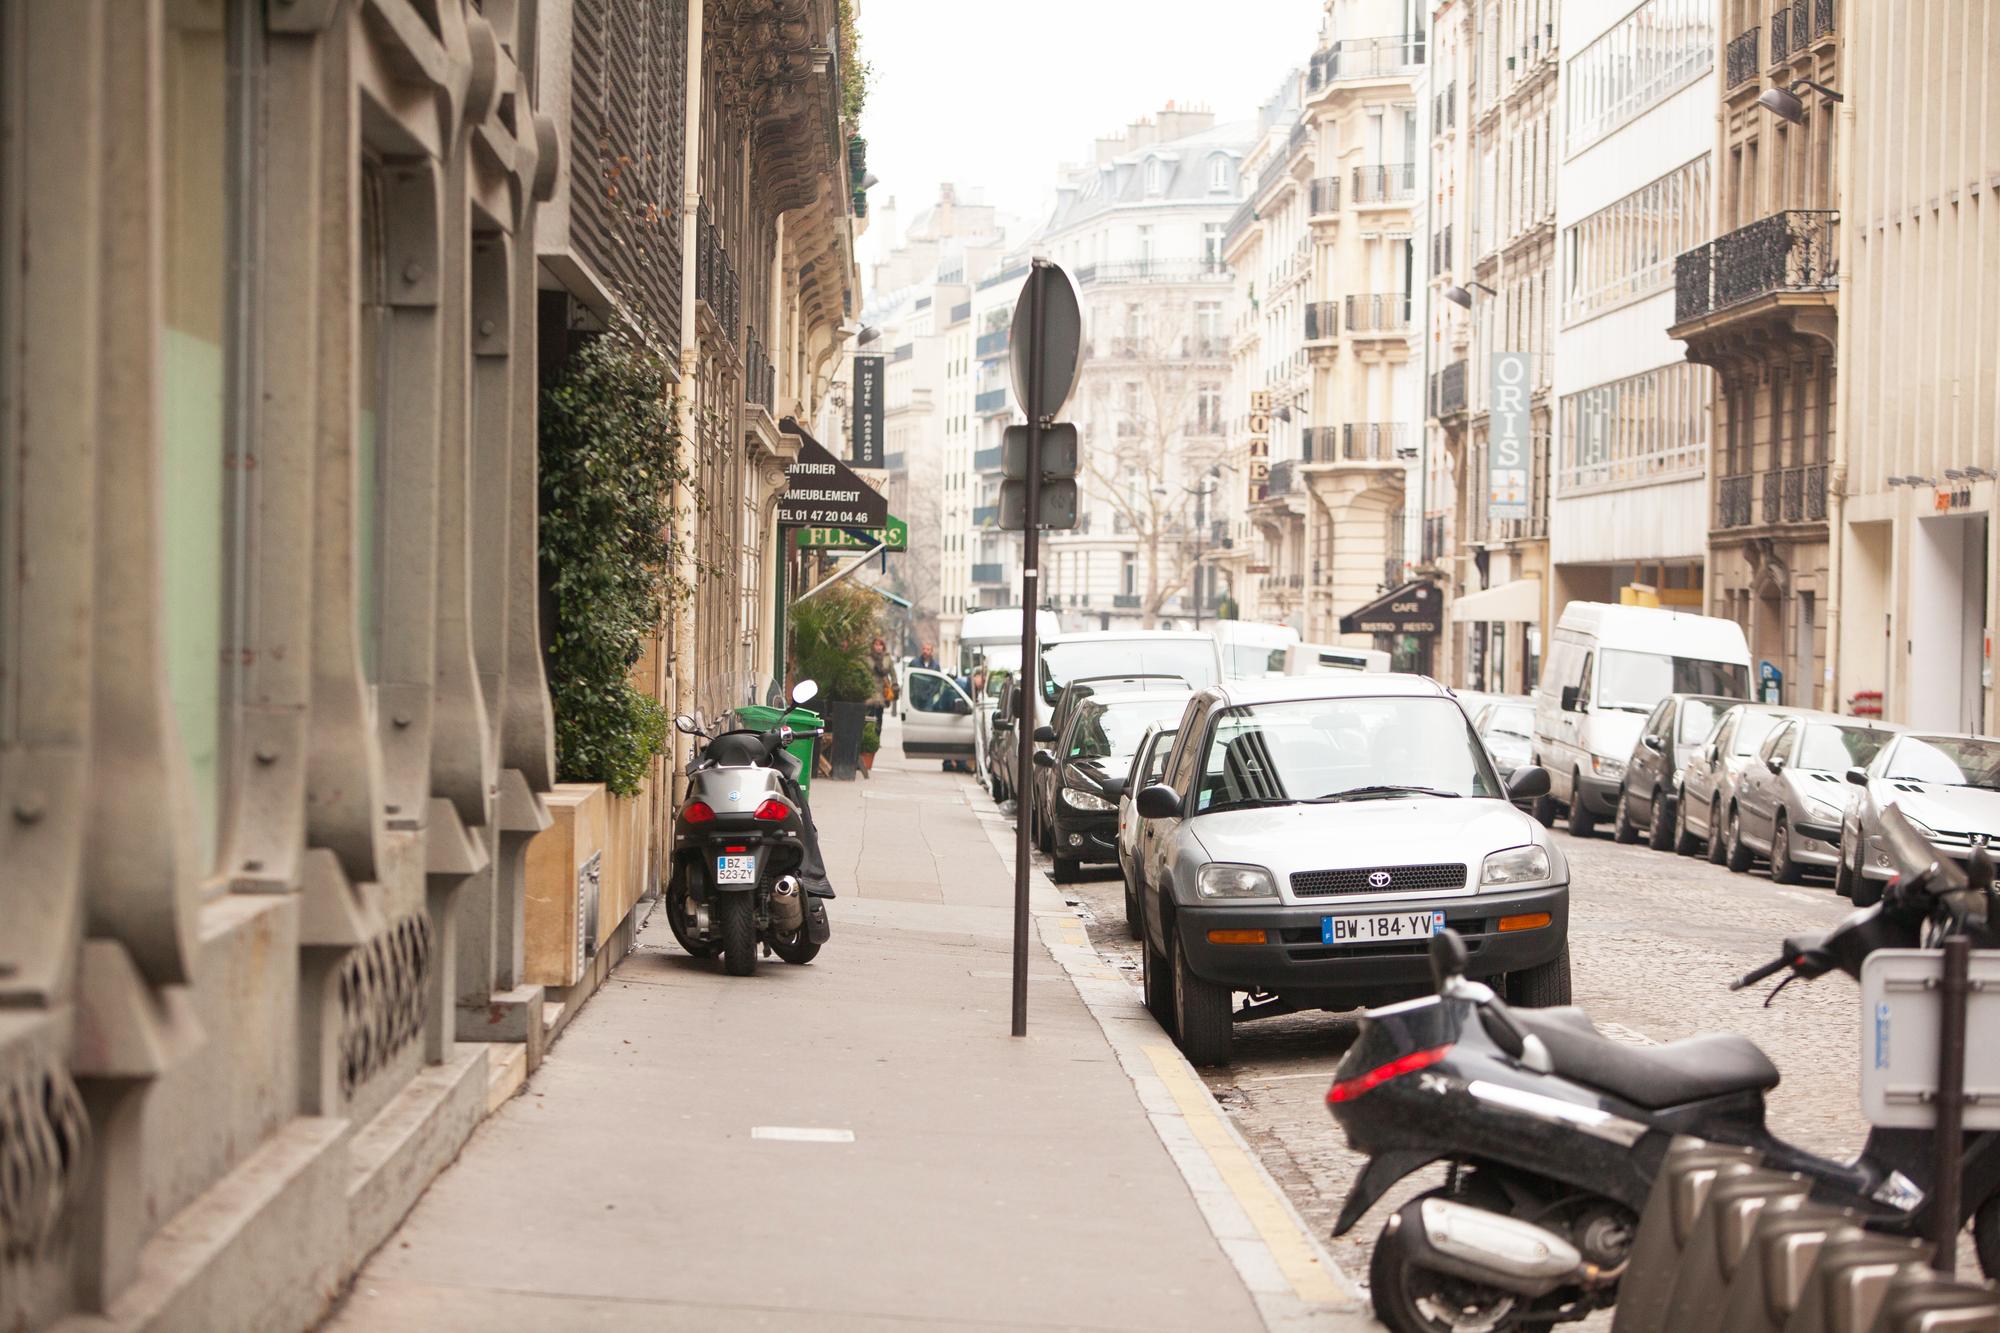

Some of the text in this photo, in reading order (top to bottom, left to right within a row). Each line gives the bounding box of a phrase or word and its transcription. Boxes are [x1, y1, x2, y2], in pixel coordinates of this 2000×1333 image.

[864, 373, 873, 462] HOTEL BASSANO
[1497, 357, 1523, 466] ORIS
[1249, 391, 1269, 504] HOTEL
[777, 509, 868, 523] TEL 01 47 20 04 46
[1392, 602, 1418, 612] CAFE
[1361, 622, 1434, 632] BISTRO RESTO
[720, 869, 752, 879] 523-ZY
